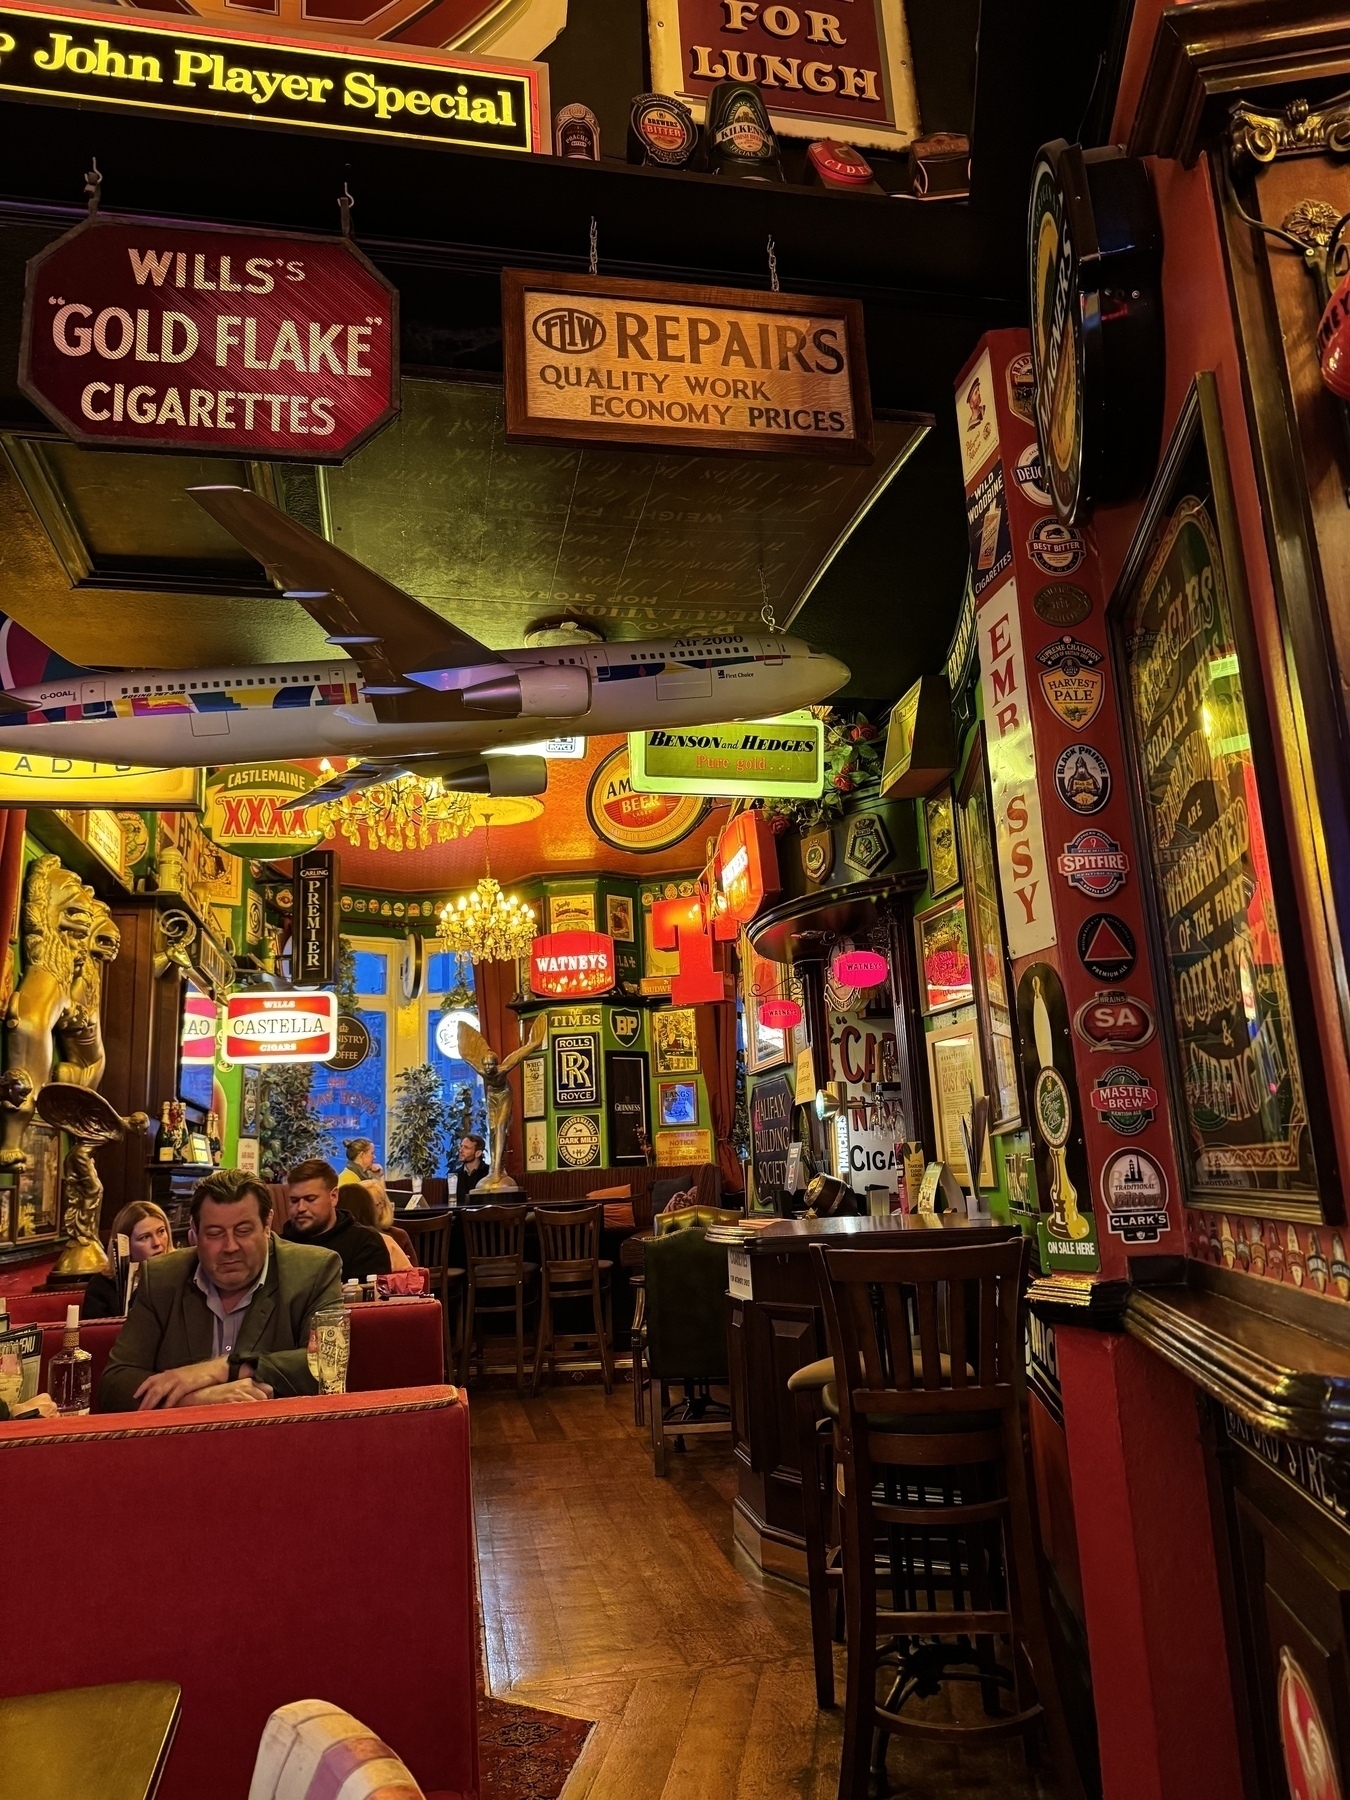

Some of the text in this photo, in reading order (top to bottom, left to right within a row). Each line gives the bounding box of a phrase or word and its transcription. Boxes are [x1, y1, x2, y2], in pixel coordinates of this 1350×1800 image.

[723, 0, 847, 45] FOR
[34, 33, 163, 83] John
[173, 49, 333, 104] Player
[344, 72, 516, 127] Special
[692, 45, 881, 101] LUNCH
[647, 118, 679, 127] BREWERS
[647, 126, 681, 137] BITTER
[127, 248, 306, 295] WILLS'S
[1040, 219, 1073, 436] MAGNERS
[615, 311, 846, 375] REPAIRS
[540, 364, 771, 401] QUALITY WORK
[81, 381, 336, 436] CIGARETTES
[590, 395, 845, 432] ECONOMY PRICES
[623, 510, 723, 523] WEIGHT
[1033, 541, 1080, 552] BEST BITTER
[975, 551, 1012, 594] CIGARETTES
[606, 594, 658, 605] HOP
[1157, 576, 1172, 612] ALL
[564, 605, 760, 623] REGULATION
[673, 635, 743, 648] Air 2000
[1040, 644, 1101, 662] SUPREME CHAMPION
[1048, 679, 1098, 690] HARVEST
[1053, 690, 1094, 701] PALE
[648, 731, 816, 753] BENSON and HEDGES
[1146, 726, 1174, 776] SOLD
[697, 754, 729, 771] Pure
[986, 613, 1039, 924] EMBSSY
[1057, 746, 1108, 775] BLACK PRINCE
[227, 769, 306, 790] CASTLEMAINE
[621, 795, 661, 813] BEER
[1187, 798, 1202, 828] ARE
[1063, 854, 1125, 872] SPITFIRE
[299, 869, 329, 878] CARLING
[1178, 875, 1248, 952] OF THE FIRST
[306, 880, 320, 967] PREMIER
[535, 954, 608, 972] WATNEYS
[847, 962, 883, 971] WATNEYS
[1092, 965, 1129, 977] PREMIUM ALE
[644, 985, 672, 994] BUDWE
[263, 1001, 296, 1009] WILLS
[233, 1017, 325, 1036] CASTELLA
[551, 1014, 601, 1026] TIMES
[615, 1015, 638, 1036] BP
[1094, 1008, 1138, 1028] SA
[336, 1033, 365, 1046] NISTRY
[1222, 1018, 1234, 1047] &
[259, 1043, 297, 1052] CIGARS
[560, 1038, 590, 1049] ROLLS
[560, 1091, 592, 1100] ROYCE
[665, 1090, 690, 1098] LANGS
[1100, 1087, 1151, 1101] MASTER
[614, 1102, 641, 1112] GUINNESS
[755, 1093, 787, 1123] HALIFAX
[559, 1136, 598, 1145] DARK MILD
[669, 1139, 695, 1147] NOTICE
[755, 1127, 790, 1153] BUILDING
[837, 1115, 849, 1173] THATCHERS
[1115, 1183, 1155, 1191] TRADITIONAL
[1114, 1191, 1160, 1208] Bitter
[1112, 1214, 1167, 1226] CLARK'S
[1047, 1241, 1095, 1256] ON SALE HERE
